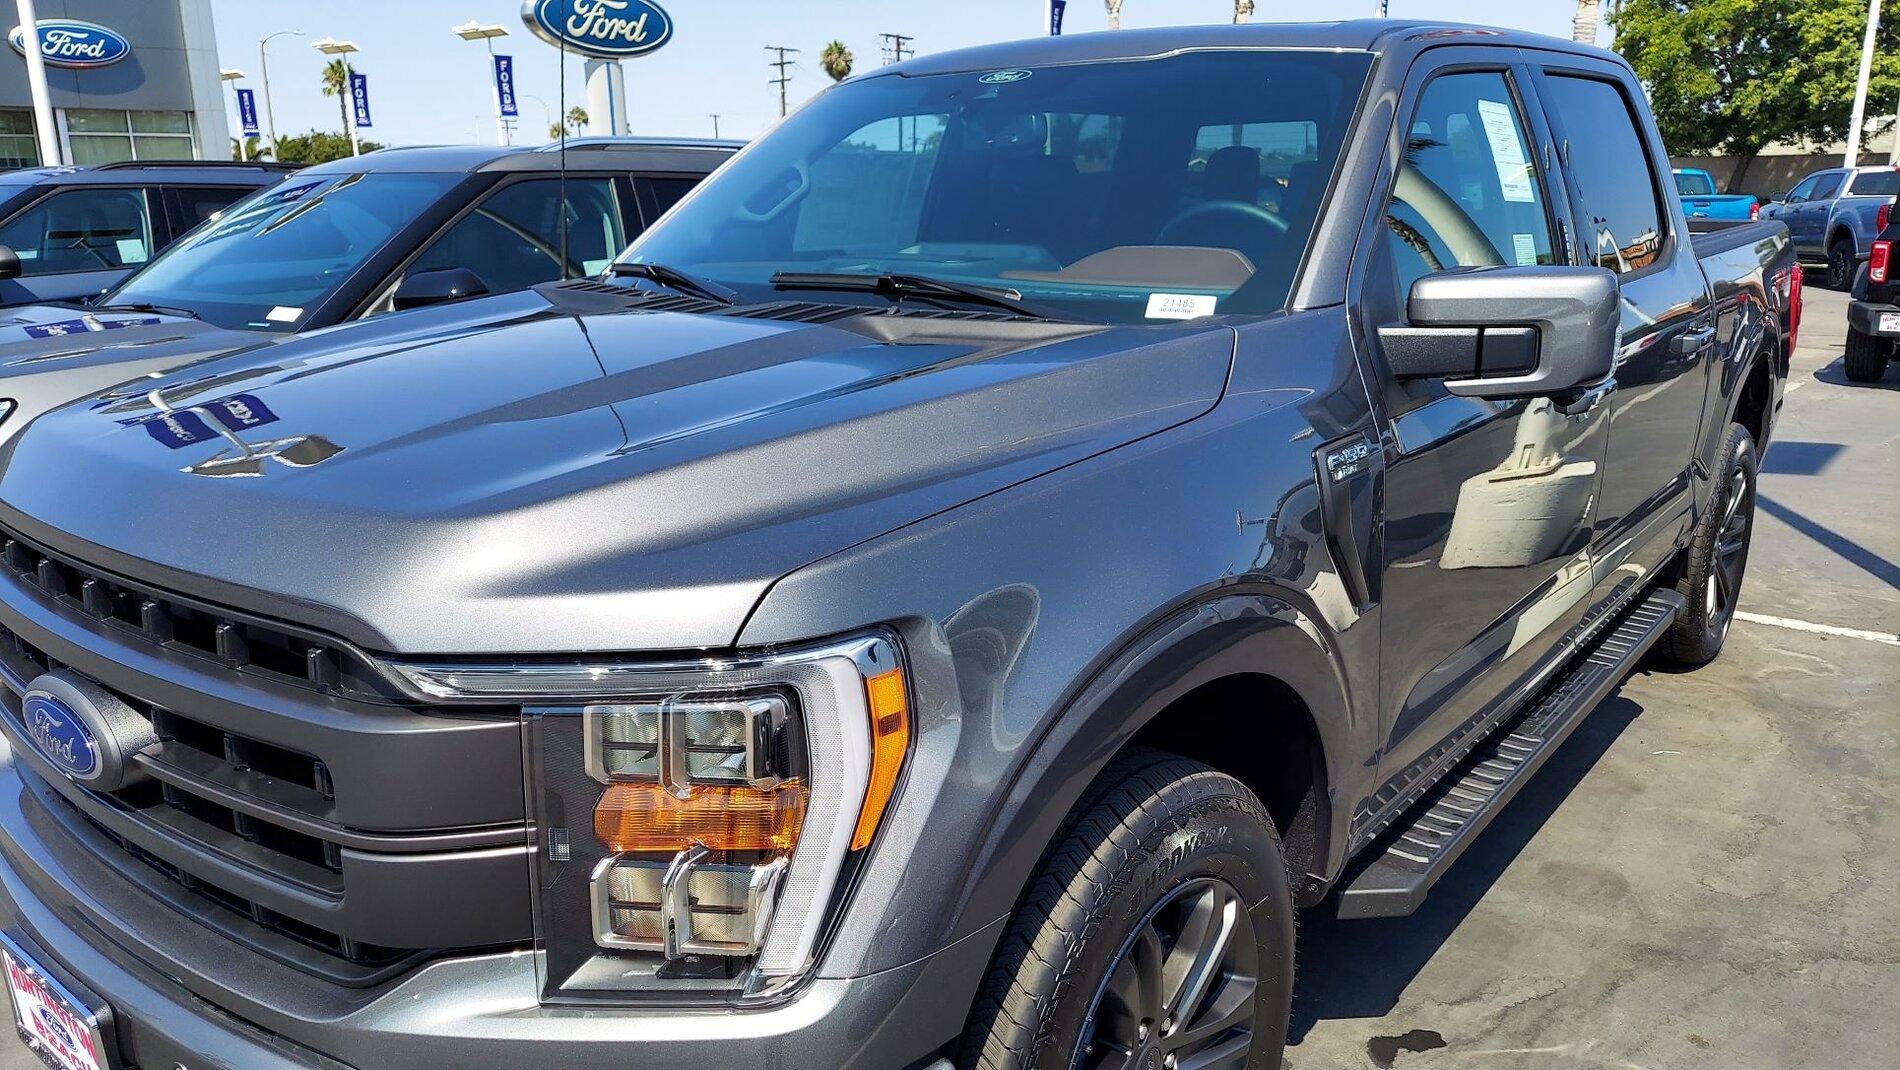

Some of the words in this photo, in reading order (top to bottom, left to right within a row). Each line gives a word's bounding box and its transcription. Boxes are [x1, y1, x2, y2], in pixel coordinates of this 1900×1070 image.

[566, 0, 648, 42] Ford
[41, 30, 105, 57] Ford
[355, 79, 366, 118] FORD
[501, 60, 511, 104] FORD
[34, 708, 76, 763] Ford
[9, 957, 98, 1067] HUNTINGTON
